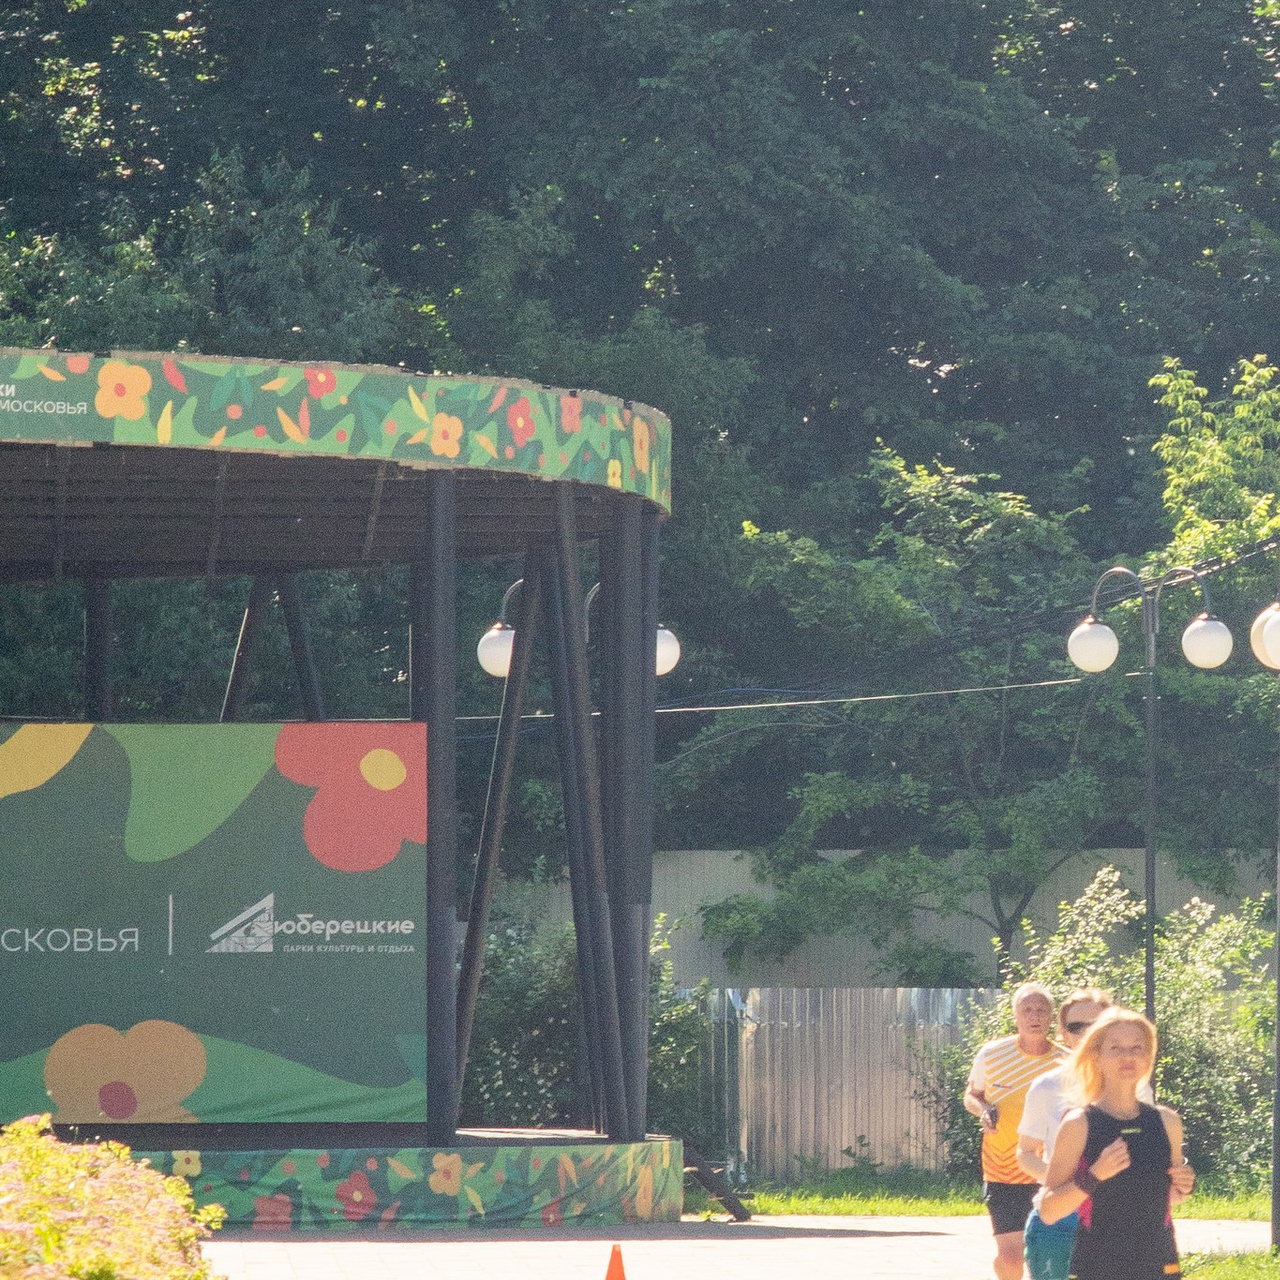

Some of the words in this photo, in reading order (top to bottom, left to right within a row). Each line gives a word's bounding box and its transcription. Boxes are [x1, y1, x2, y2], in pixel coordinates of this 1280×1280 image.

[0, 927, 139, 952] СКОВЬЯ
[283, 944, 314, 953] ПАРКИ
[316, 944, 365, 953] КУЛЬТУРЫ
[367, 944, 375, 952] И
[377, 944, 415, 953] ОТДЫХА
